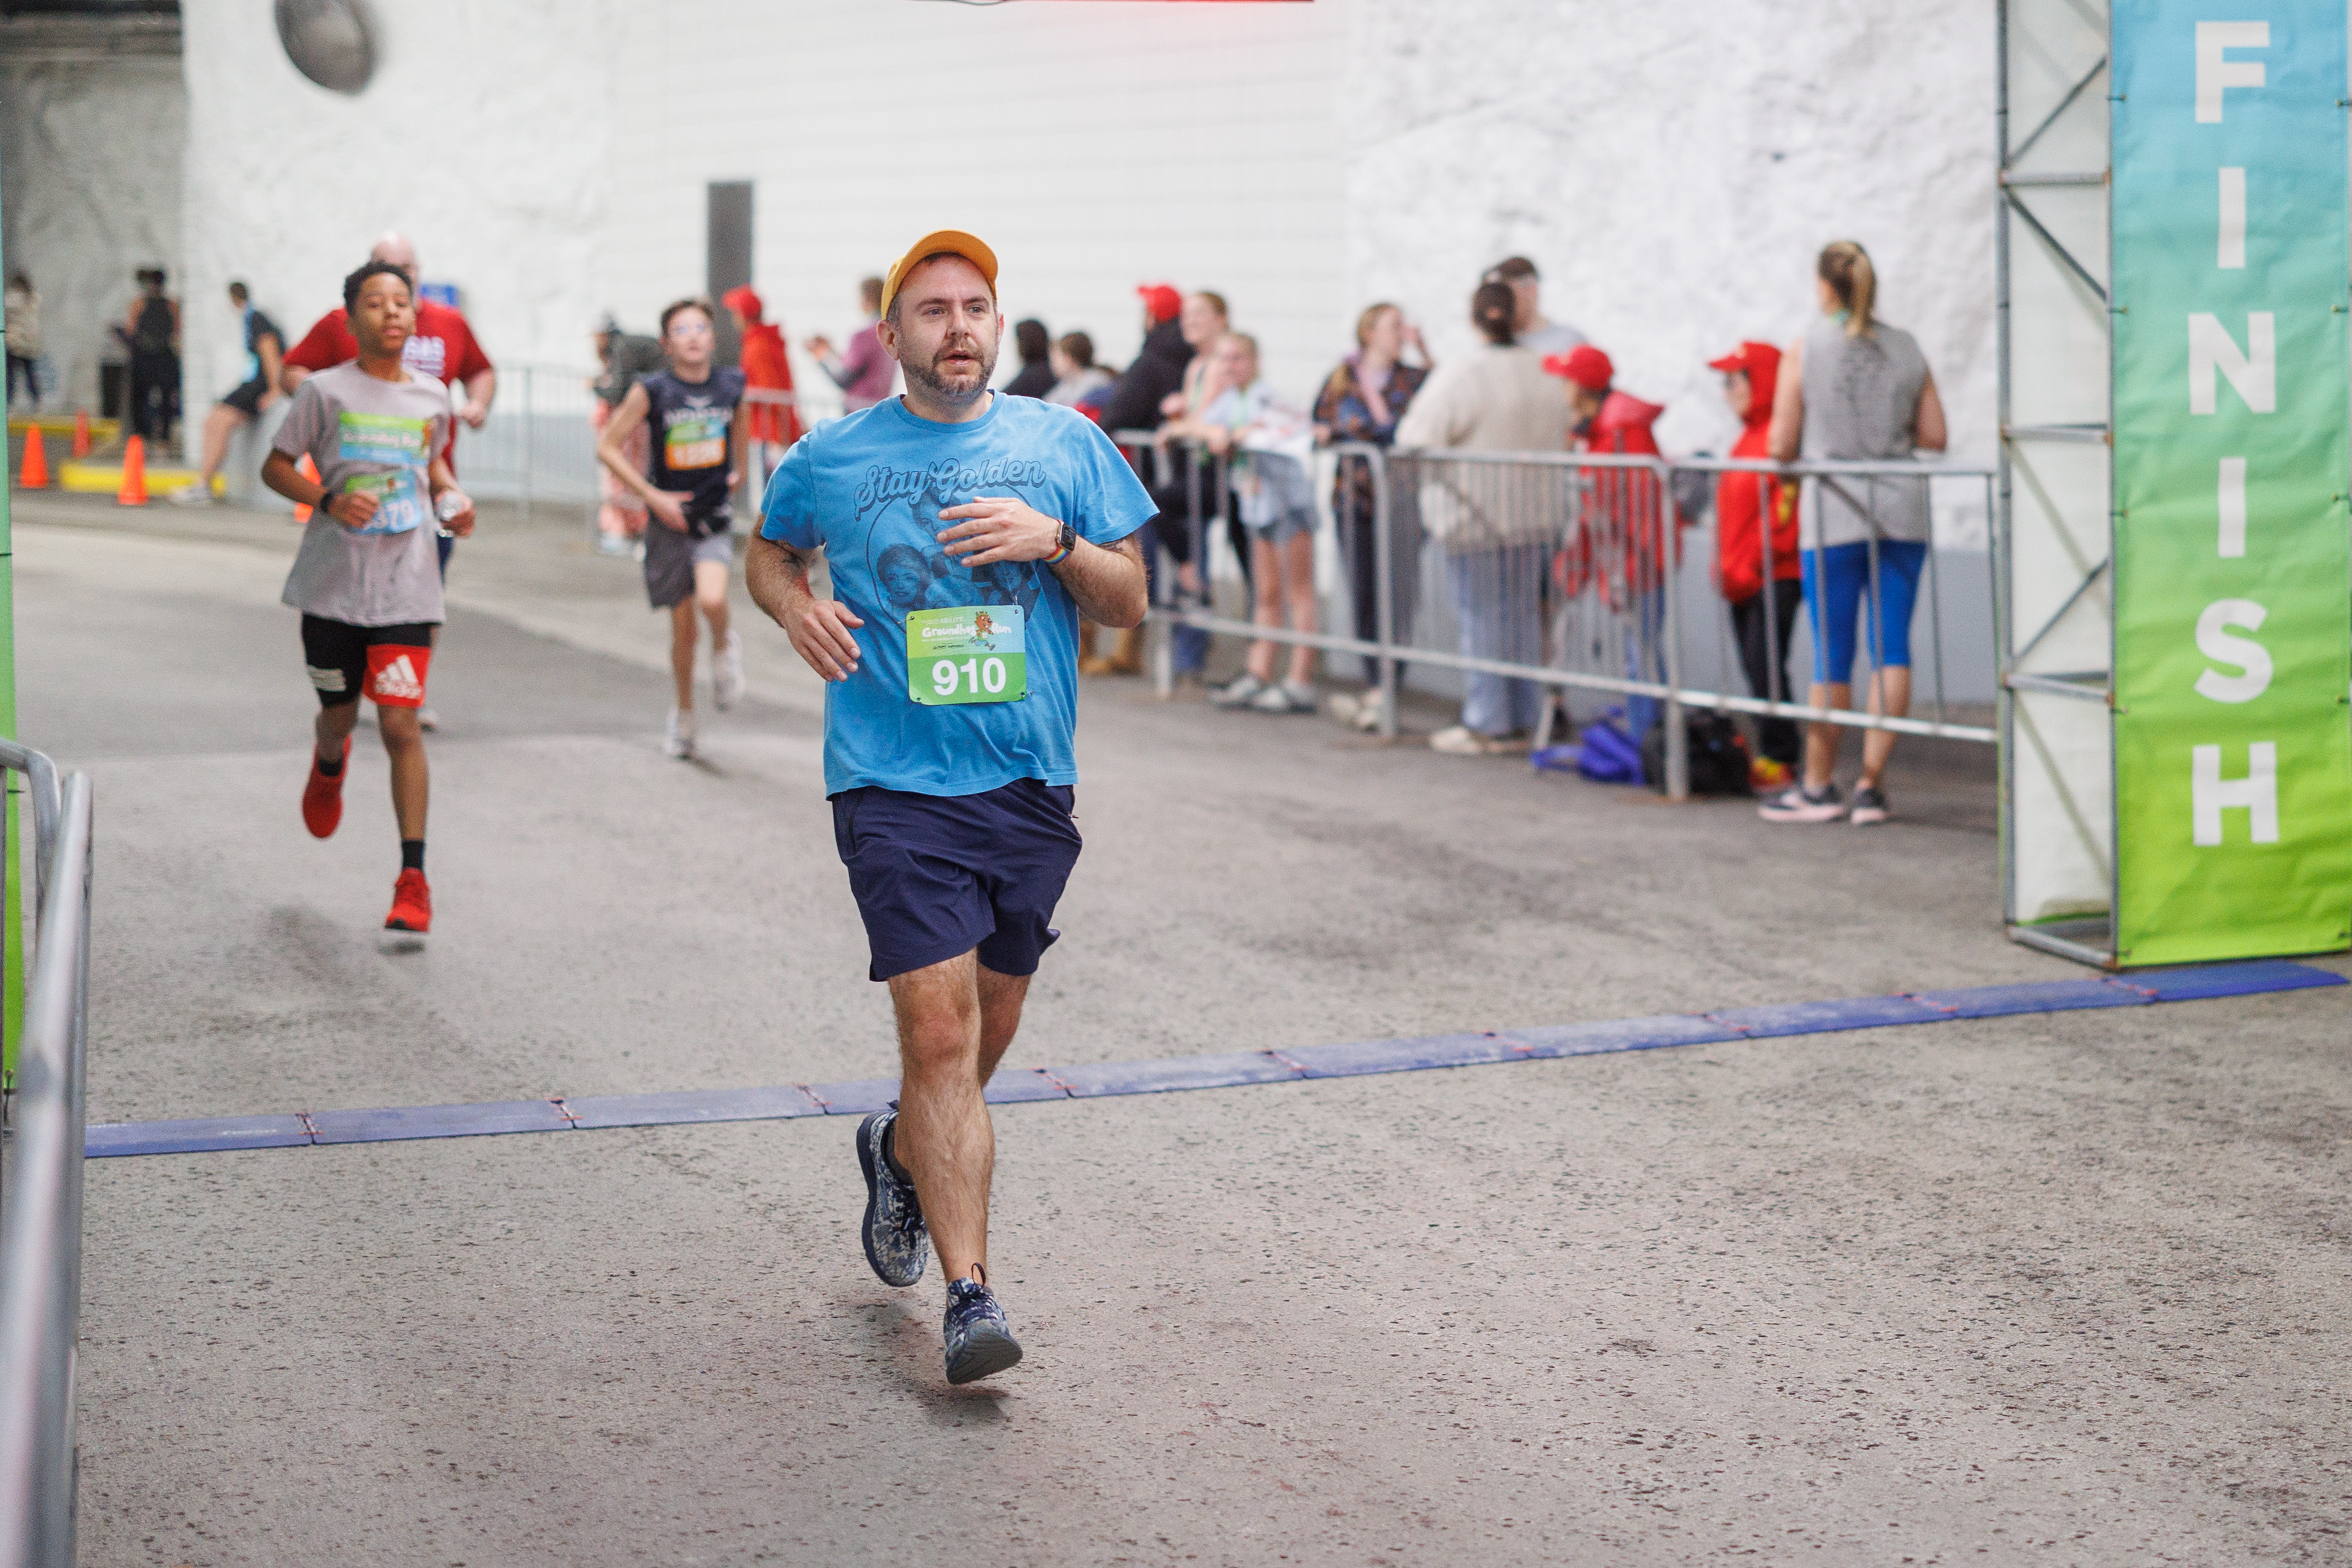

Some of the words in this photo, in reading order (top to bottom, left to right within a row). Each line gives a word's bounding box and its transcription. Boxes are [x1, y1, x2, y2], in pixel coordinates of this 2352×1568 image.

[2188, 20, 2279, 845] FINISH
[854, 465, 931, 522] Stay
[928, 457, 1046, 508] Golden
[364, 498, 415, 529] 379
[921, 623, 978, 638] Groundhog
[992, 622, 1012, 635] Run
[939, 615, 964, 624] ABILITY
[931, 656, 1007, 697] 910
